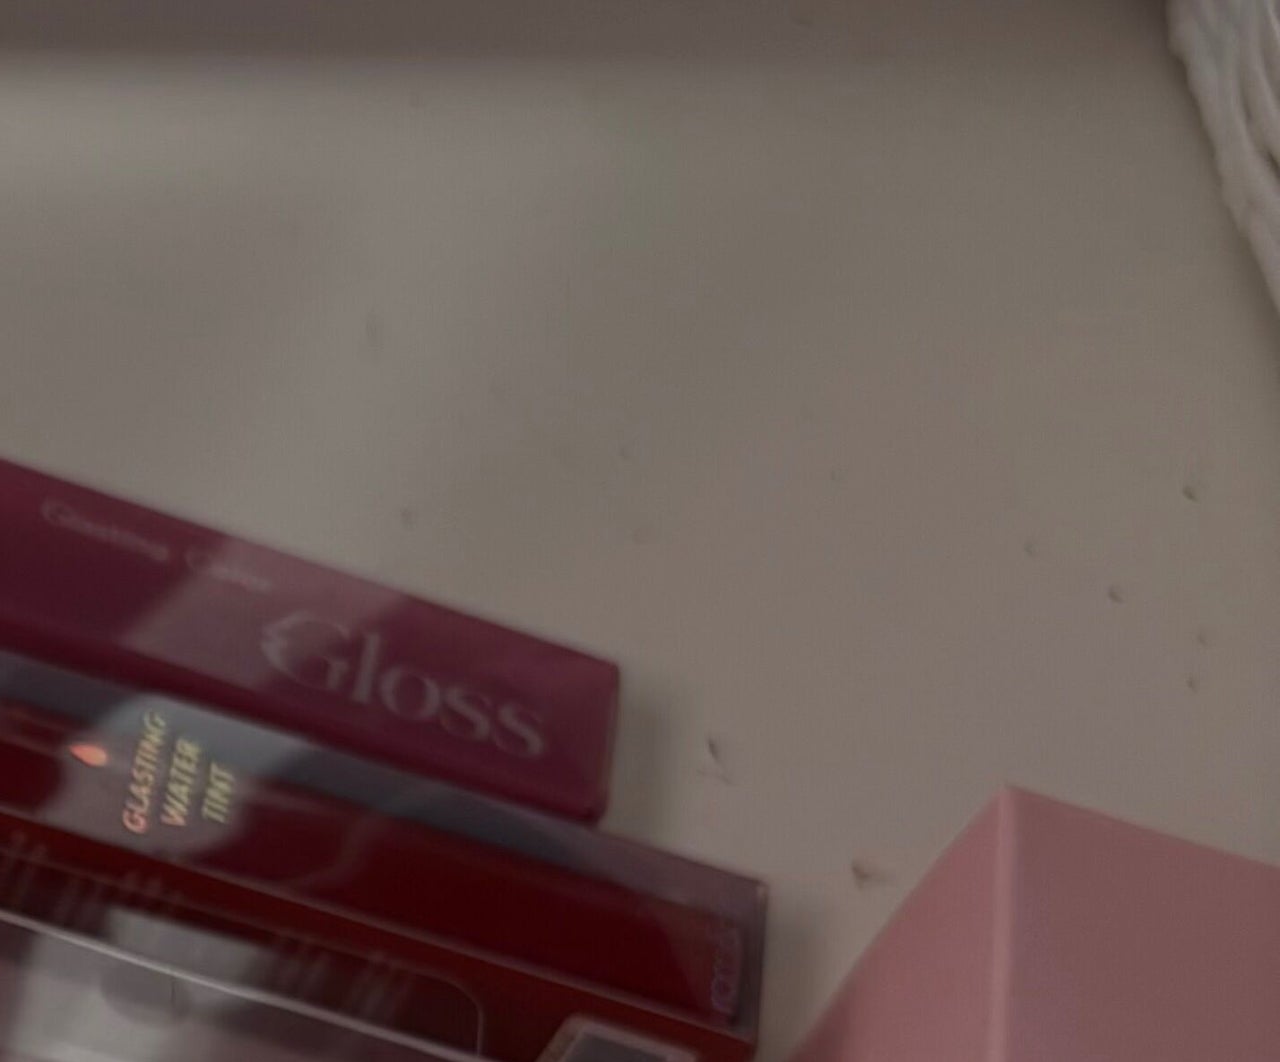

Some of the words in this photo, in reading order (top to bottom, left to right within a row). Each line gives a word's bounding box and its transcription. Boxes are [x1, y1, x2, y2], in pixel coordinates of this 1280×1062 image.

[259, 608, 545, 759] Gloss
[121, 711, 169, 837] GLASTING
[160, 736, 202, 828] WATER
[201, 760, 235, 825] TINT
